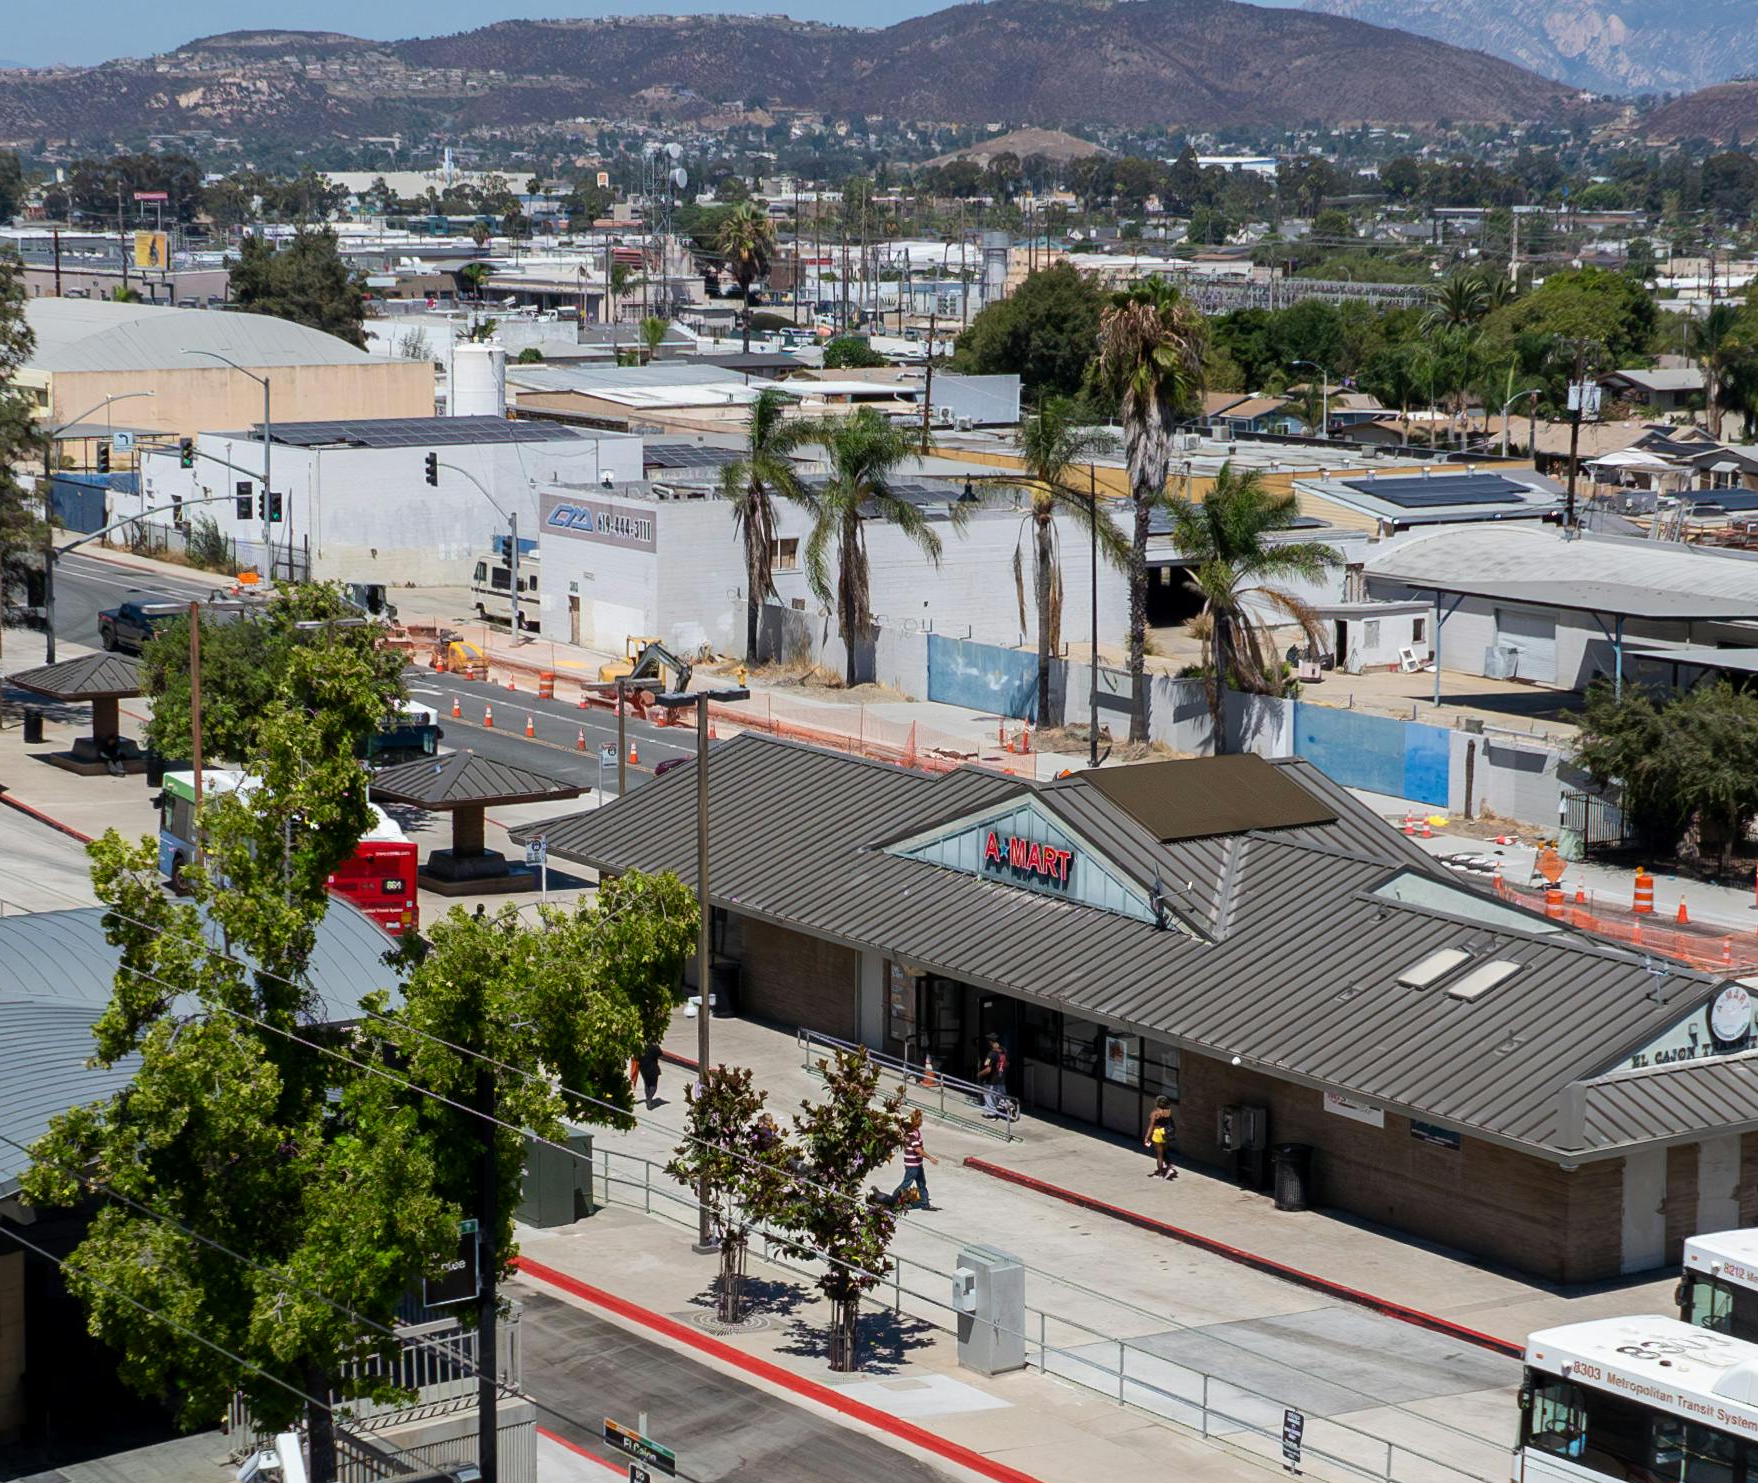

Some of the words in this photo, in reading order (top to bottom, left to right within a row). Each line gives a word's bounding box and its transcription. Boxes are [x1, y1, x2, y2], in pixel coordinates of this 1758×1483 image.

[597, 512, 651, 542] 619-444-3111
[1009, 834, 1072, 881] MART
[1631, 1053, 1649, 1069] EL
[1654, 1046, 1699, 1065] CAJON
[1573, 1360, 1601, 1380] 8303
[1606, 1371, 1674, 1404] Metropolitan
[1677, 1394, 1714, 1416] Transit
[1717, 1408, 1758, 1432] System
